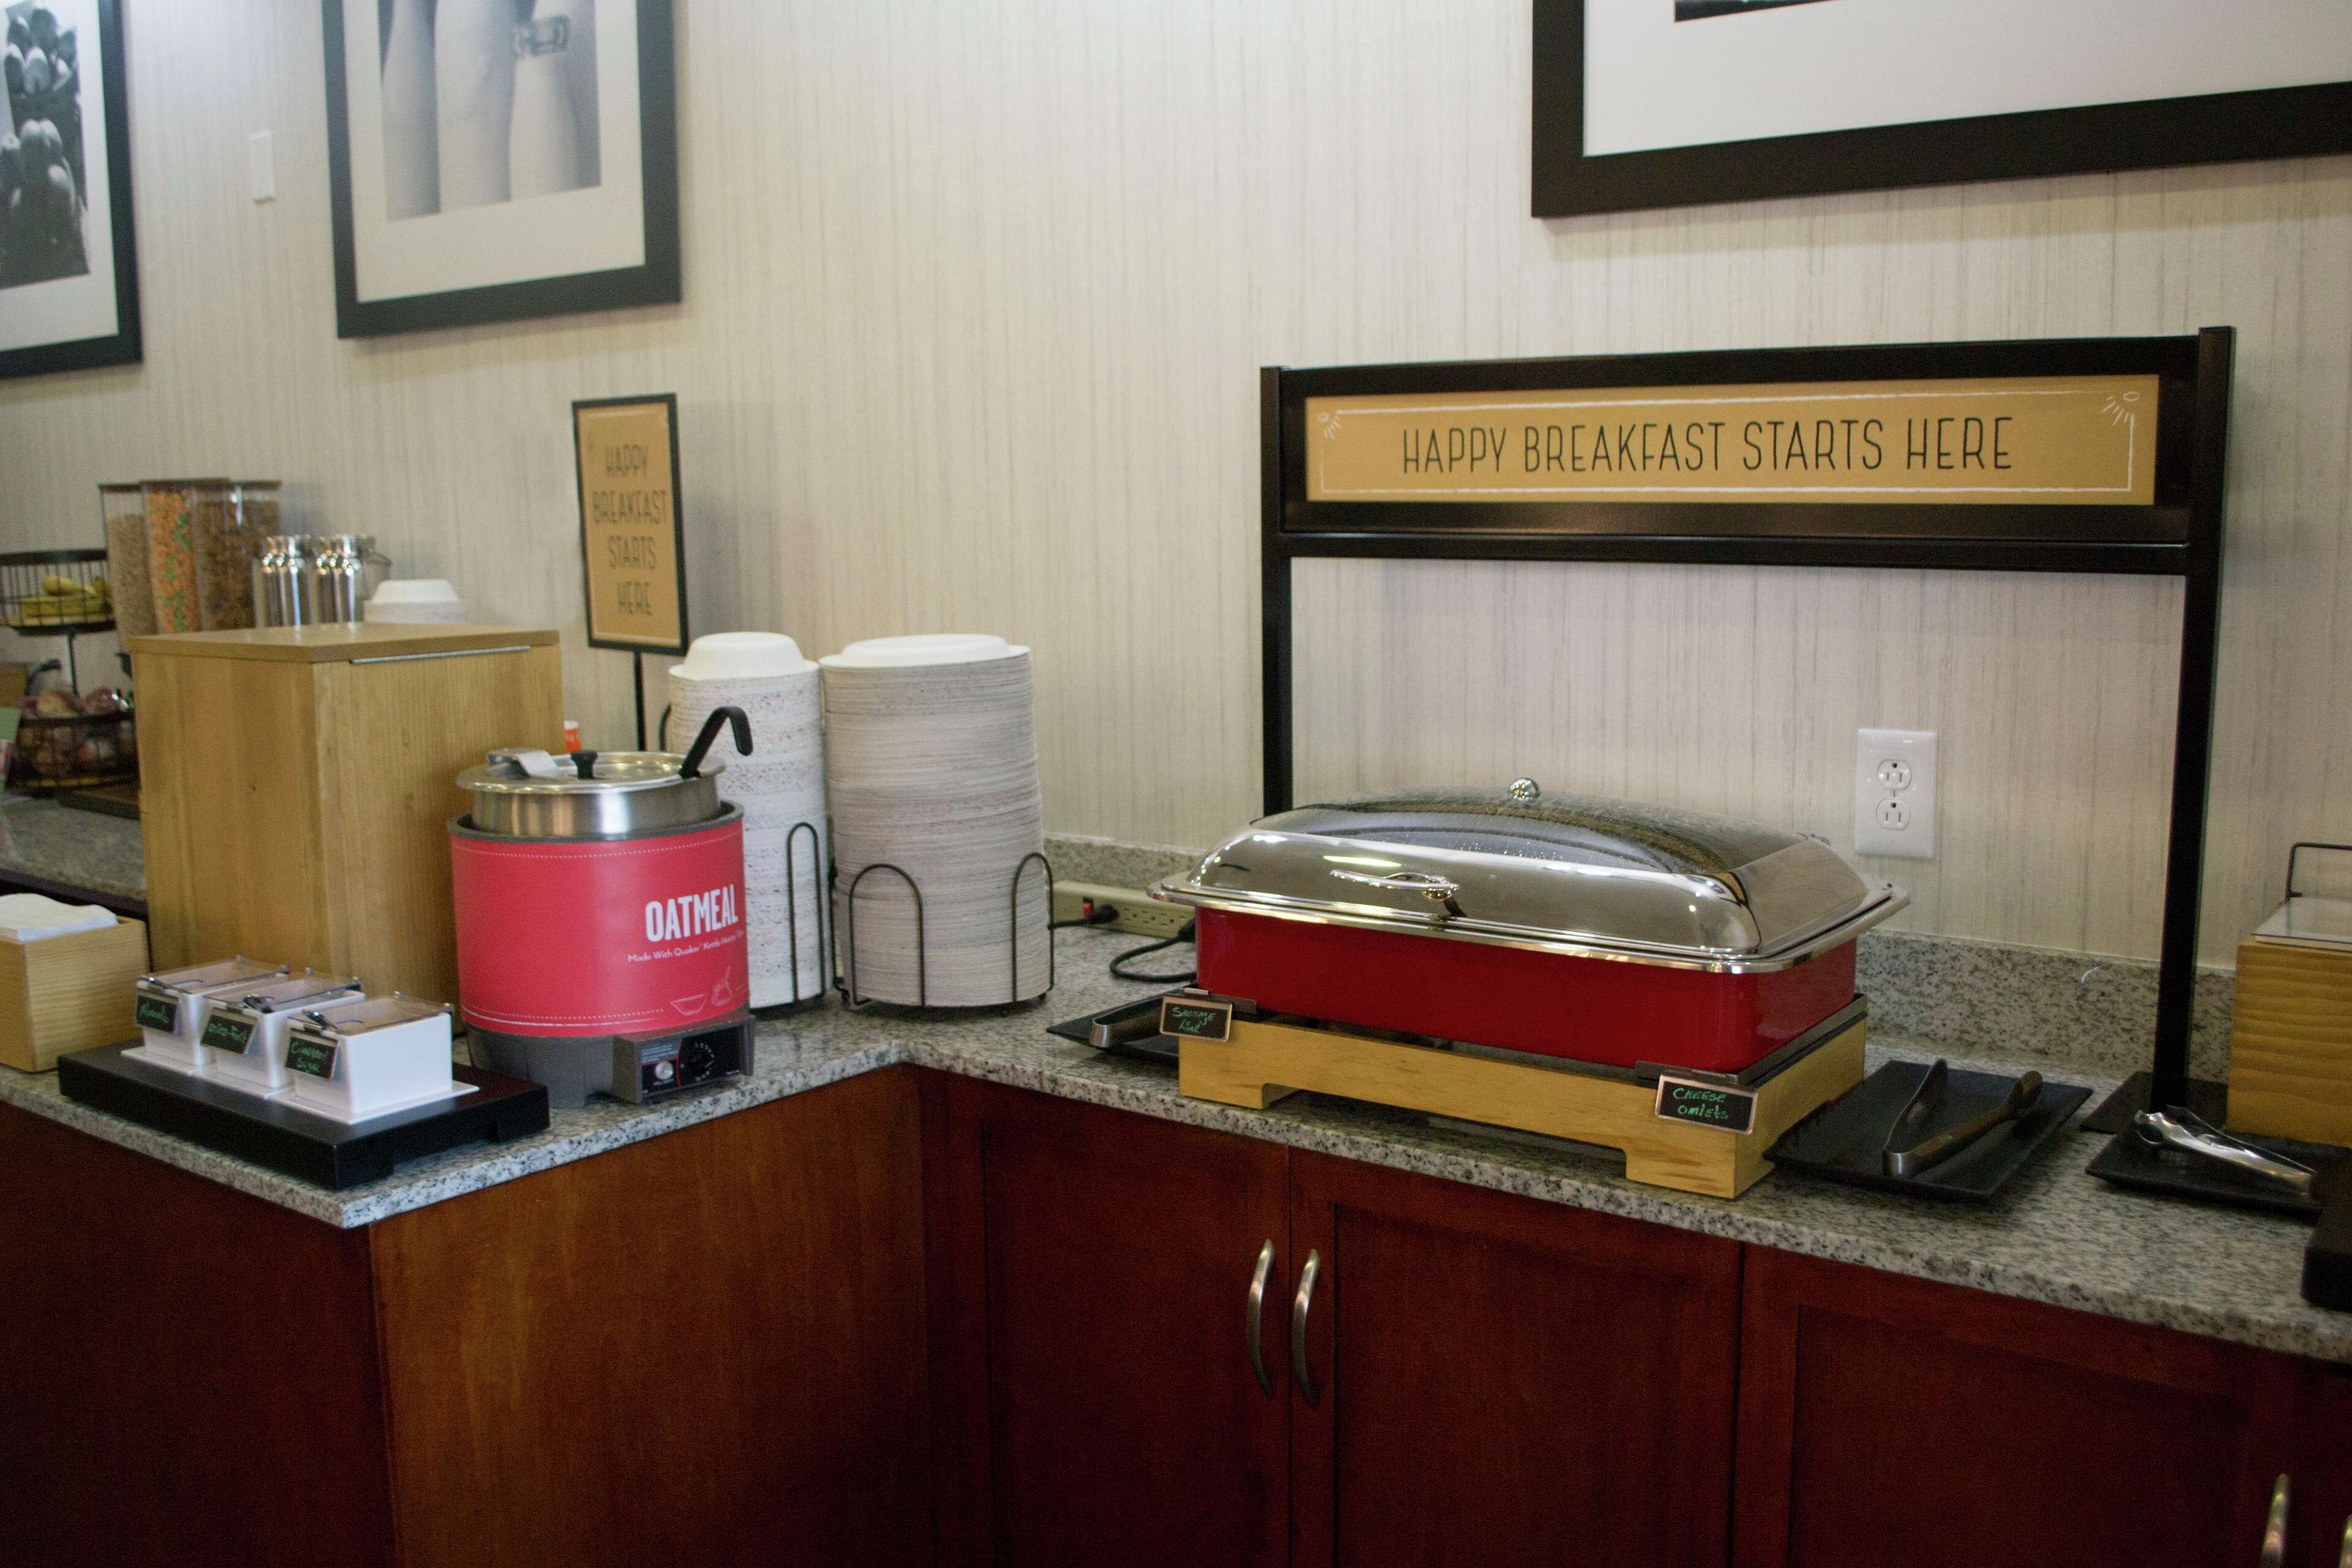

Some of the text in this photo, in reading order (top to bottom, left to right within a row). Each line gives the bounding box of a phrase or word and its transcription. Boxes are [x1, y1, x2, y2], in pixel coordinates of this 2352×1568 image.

[604, 443, 648, 478] HAPPY
[1403, 417, 2013, 474] HAPPY BREAKFAST STARTS HERE
[592, 489, 667, 525] BREAKFAST
[608, 535, 657, 570] STARTS
[617, 581, 653, 616] HERE
[645, 884, 739, 943] OATMEAL
[627, 952, 652, 963] Made
[653, 949, 673, 959] With
